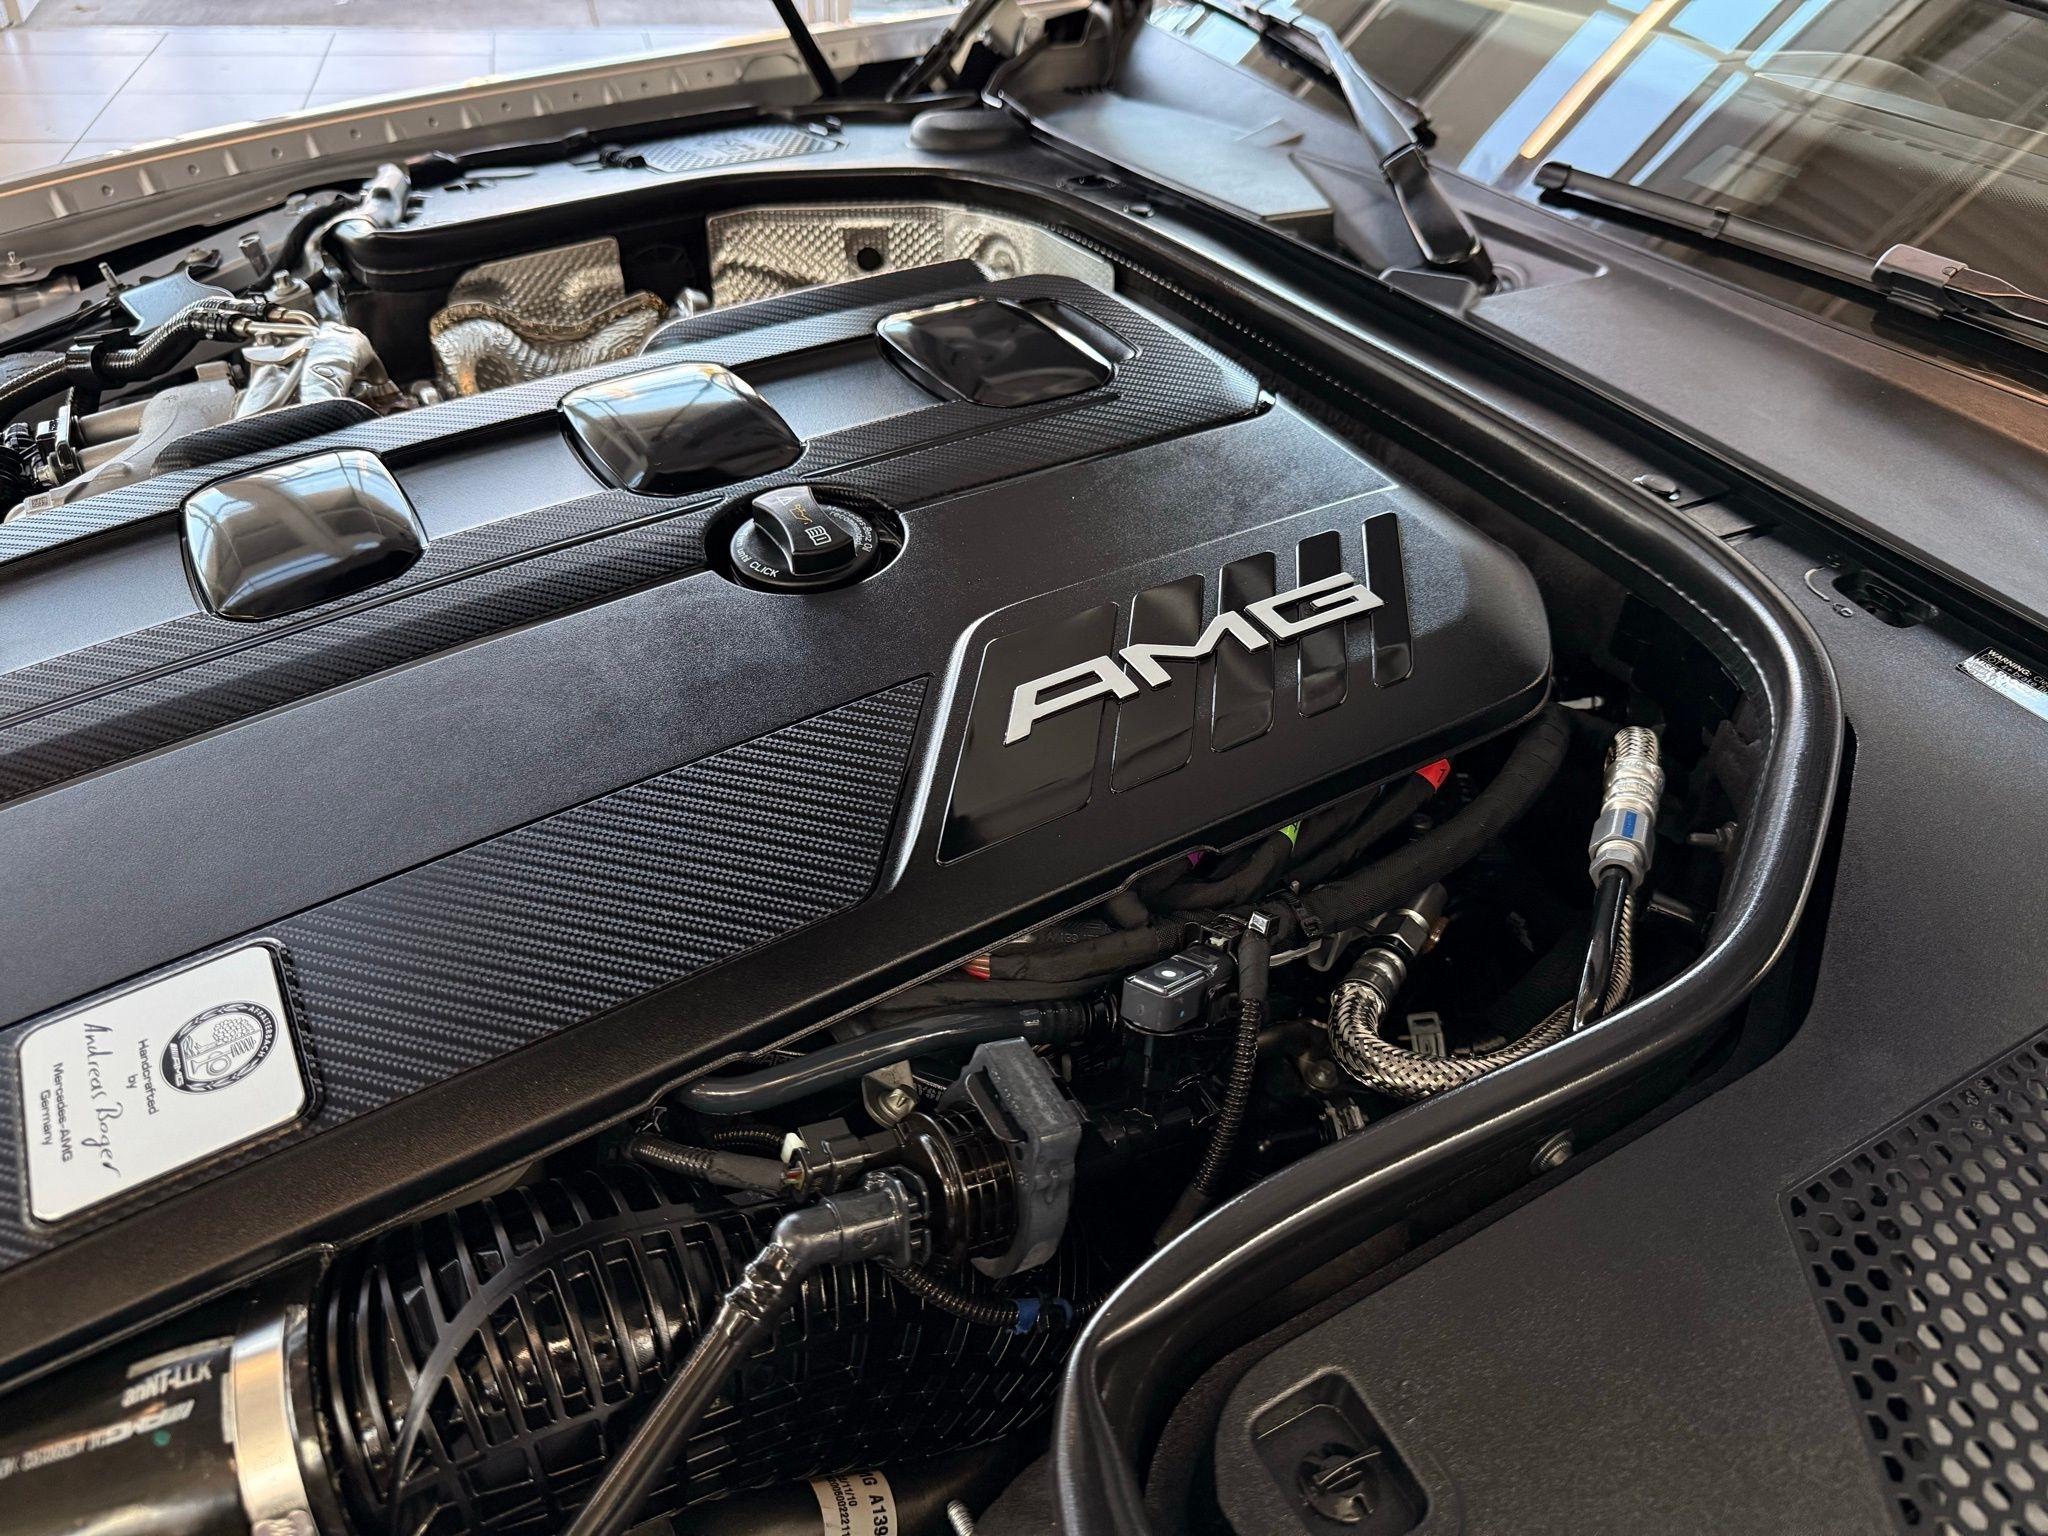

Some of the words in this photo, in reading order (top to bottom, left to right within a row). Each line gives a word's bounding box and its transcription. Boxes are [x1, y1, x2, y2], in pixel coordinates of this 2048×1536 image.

[750, 561, 779, 577] CLICK
[1003, 571, 1385, 747] AMG
[1988, 649, 2032, 677] WARNING:
[248, 1006, 273, 1058] AFFALTERBACH
[84, 1023, 113, 1099] Andreas
[126, 1073, 138, 1089] by
[138, 1038, 159, 1115] Handcrafted
[40, 1089, 53, 1146] Germany
[53, 1062, 73, 1162] Mercedes-AMG
